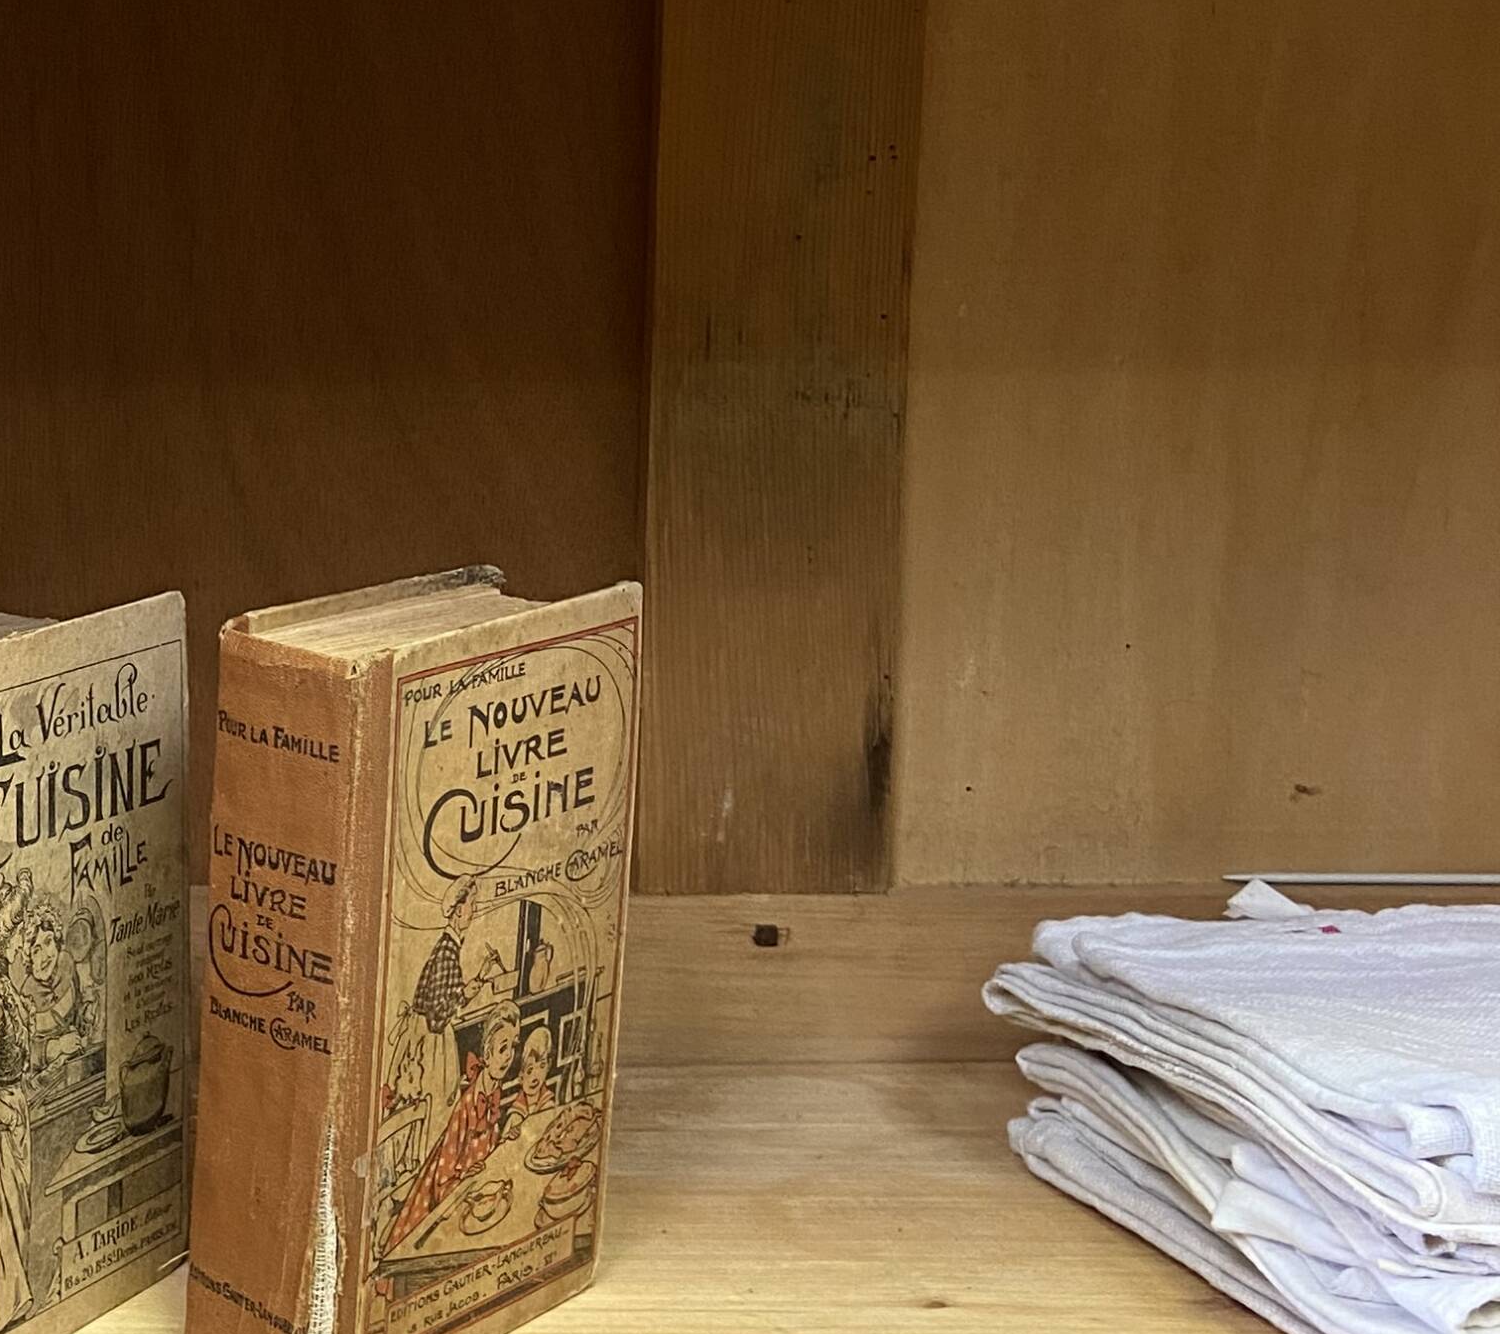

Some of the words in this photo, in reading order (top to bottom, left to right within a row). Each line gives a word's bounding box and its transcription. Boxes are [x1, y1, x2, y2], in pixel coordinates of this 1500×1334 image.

[36, 662, 149, 744] Véritable
[404, 682, 442, 707] POUR
[471, 661, 526, 689] FAMILLE
[424, 718, 453, 749] LE
[468, 674, 602, 749] NOUVEAU
[250, 725, 269, 747] LA
[272, 725, 340, 764] FAMILLE
[475, 727, 568, 780] LIVRE
[511, 771, 528, 784] DE
[102, 823, 123, 845] de
[422, 766, 596, 880] CUISINE
[69, 831, 148, 909] FAMILLE
[213, 823, 233, 857] LE
[237, 836, 338, 886] NOUVEAU
[494, 861, 563, 898] BLANCHE
[564, 841, 623, 882] CARAMEL
[230, 870, 307, 920] LIVRE
[110, 913, 143, 945] Tante
[143, 896, 180, 933] Marie
[256, 913, 274, 931] DE
[208, 903, 334, 997] CUISINE
[209, 994, 266, 1035] BLANCHE
[269, 1017, 332, 1056] CARAMEL
[286, 990, 317, 1024] PAR
[91, 1217, 138, 1252] TARIDE
[390, 1289, 440, 1323] EDITIONS
